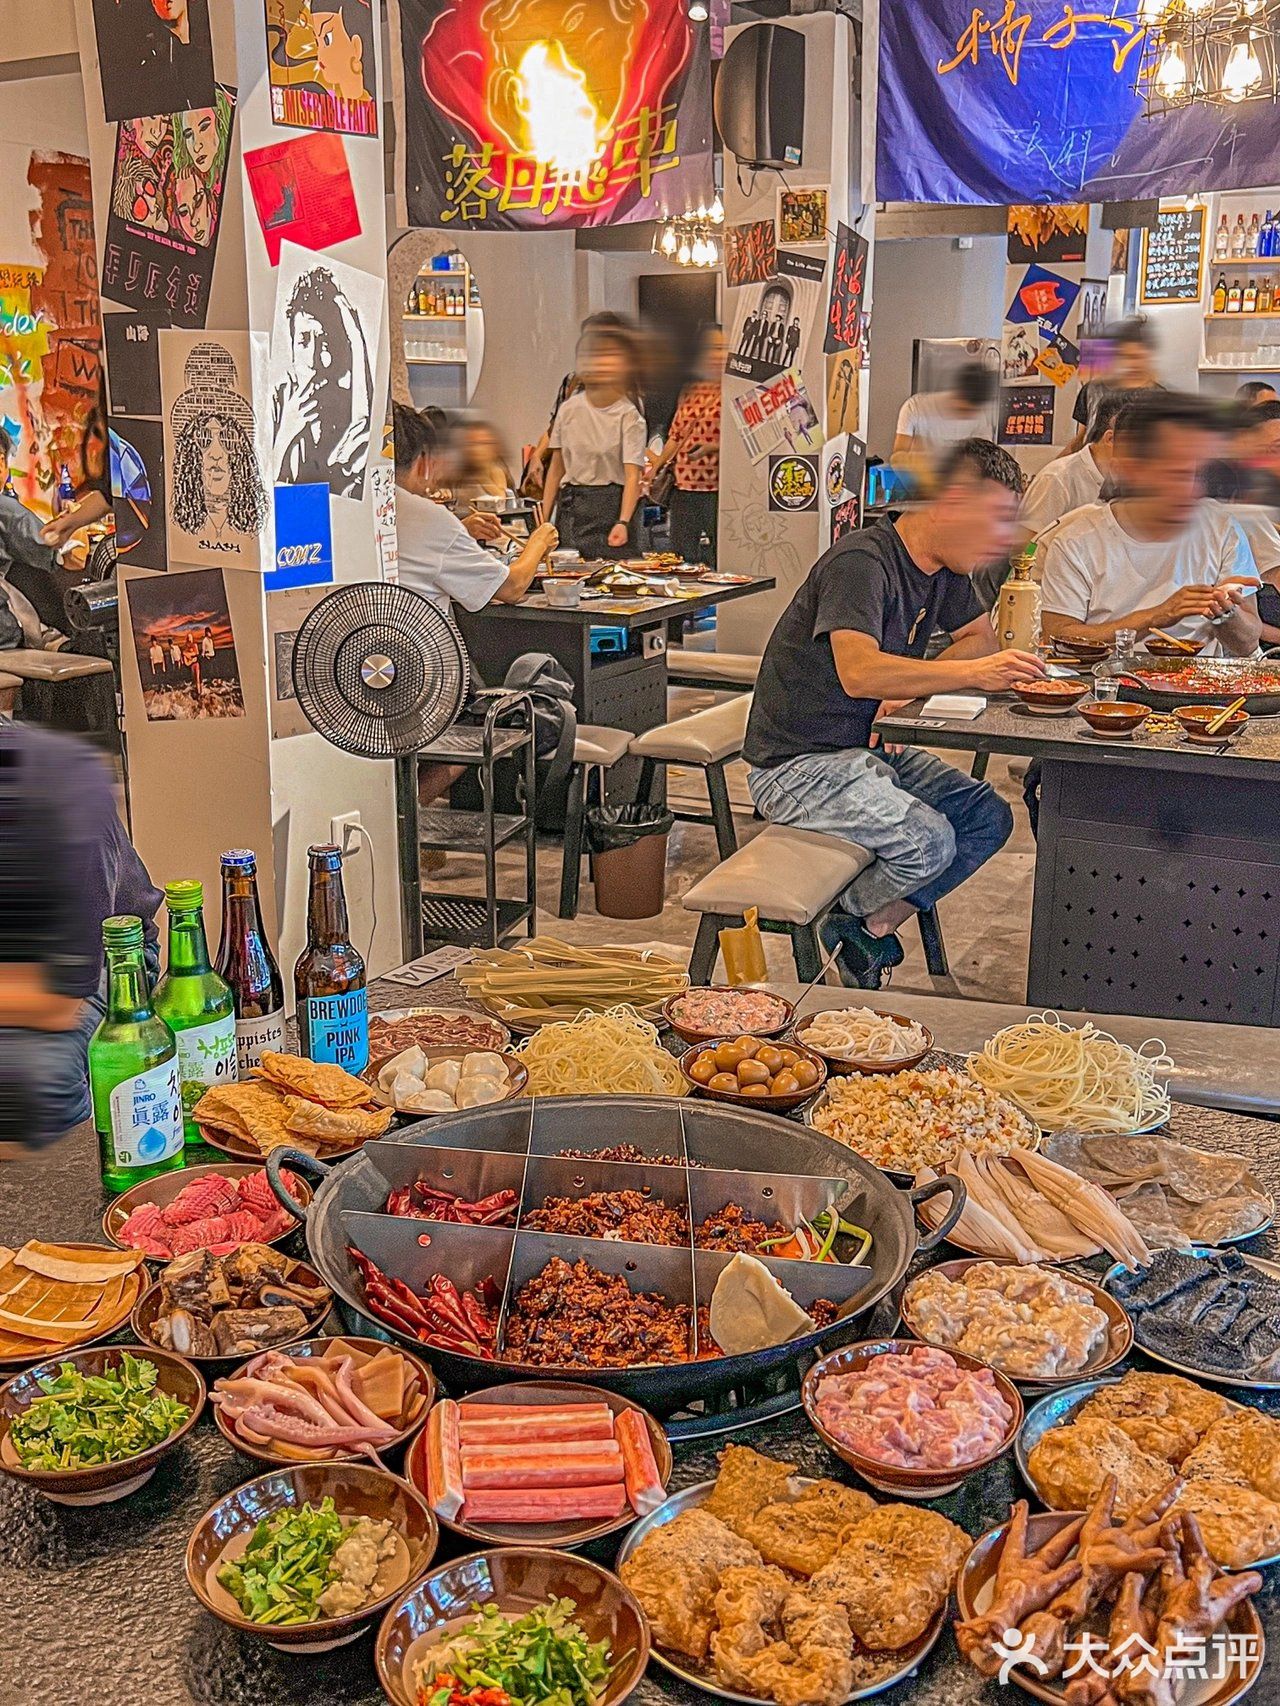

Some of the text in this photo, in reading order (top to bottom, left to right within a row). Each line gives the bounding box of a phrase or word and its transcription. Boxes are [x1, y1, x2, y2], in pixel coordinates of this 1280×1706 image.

[284, 89, 377, 134] MISERABLE FAITH
[0, 307, 43, 337] der
[198, 540, 241, 553] SLASH
[326, 1027, 360, 1047] PUNK
[335, 1046, 356, 1064] IPA
[133, 1092, 156, 1106] JINRO
